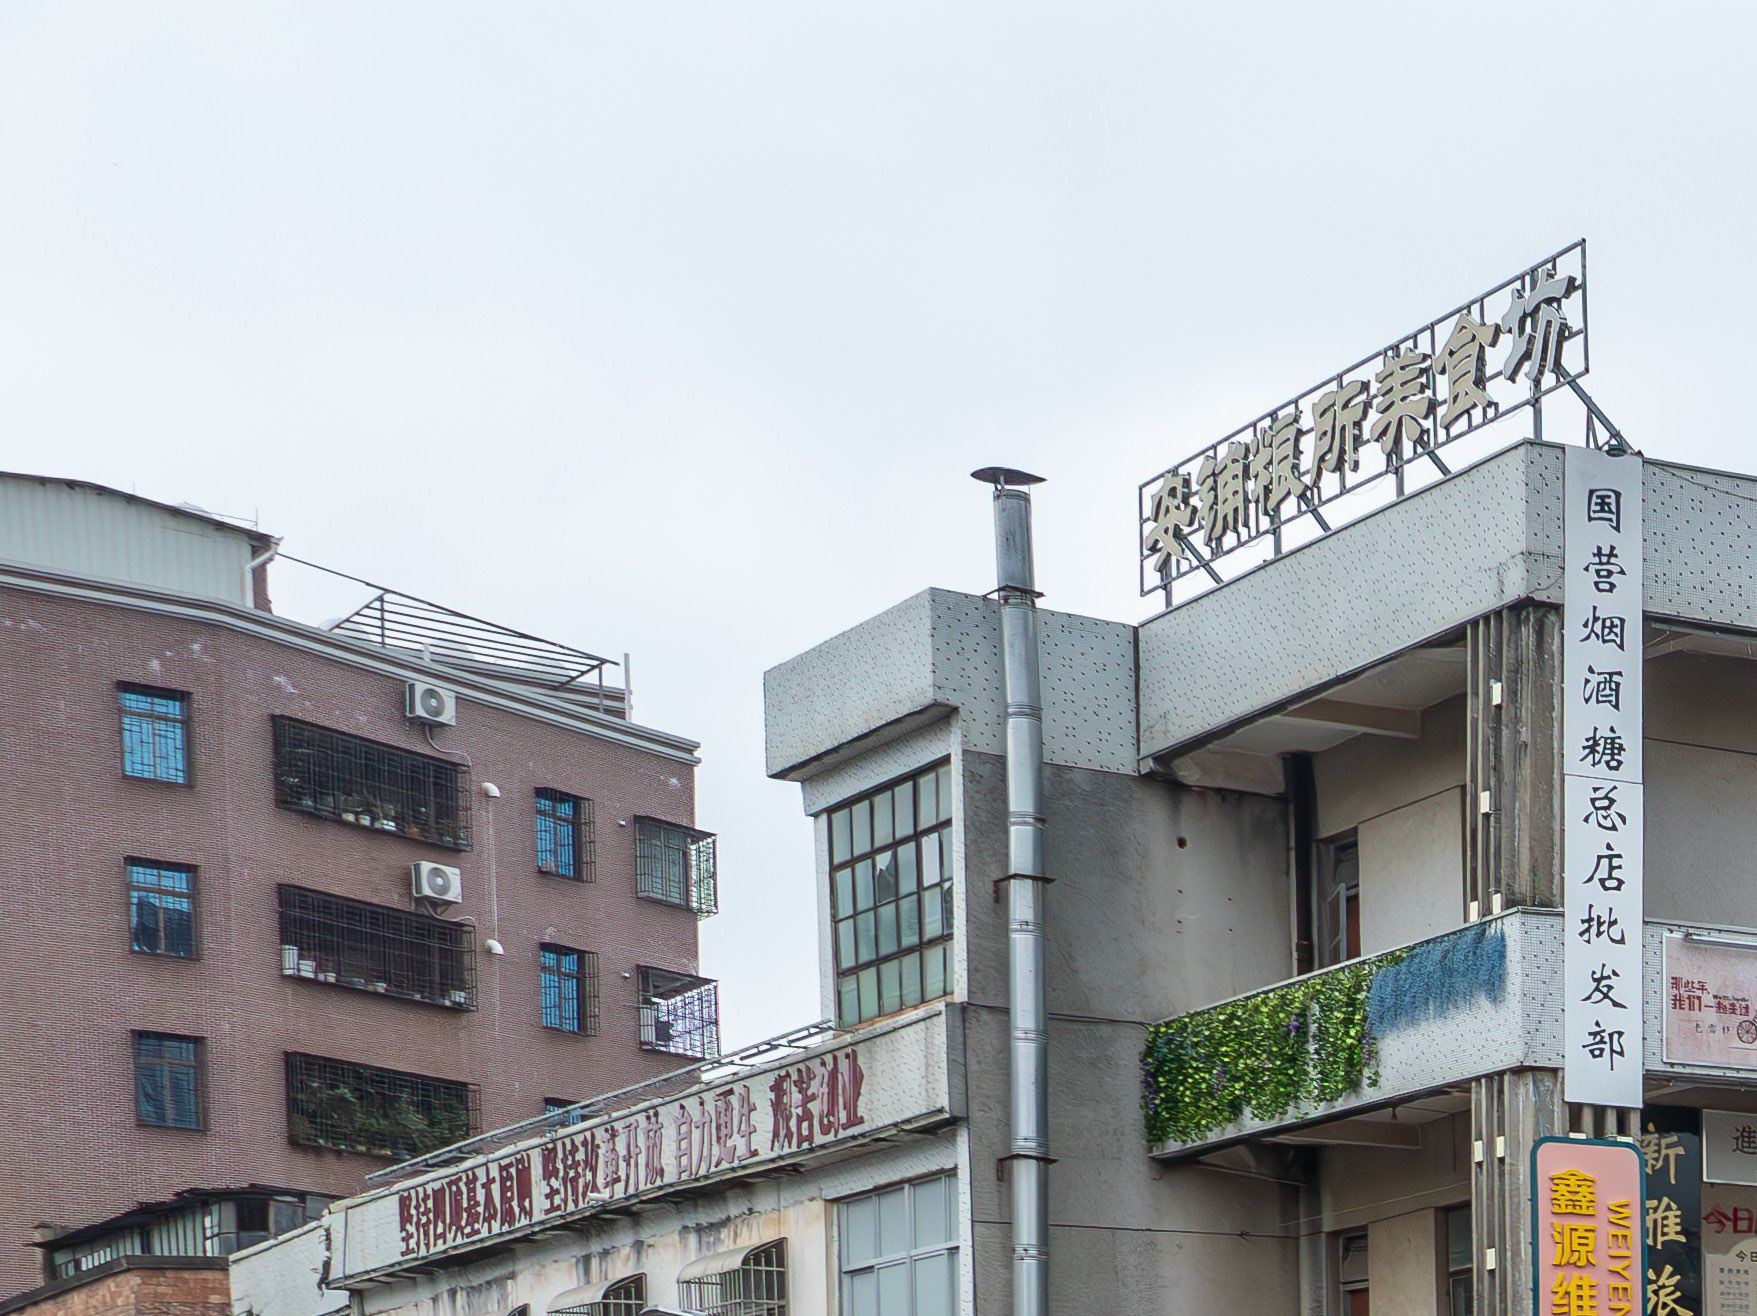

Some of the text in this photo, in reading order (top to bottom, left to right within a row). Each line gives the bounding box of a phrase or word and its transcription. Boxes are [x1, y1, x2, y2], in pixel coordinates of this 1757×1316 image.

[1577, 486, 1628, 1073] 国营烟酒糖总店批发部
[675, 1083, 760, 1180] 自力更生
[768, 1047, 866, 1152] 艰苦创业
